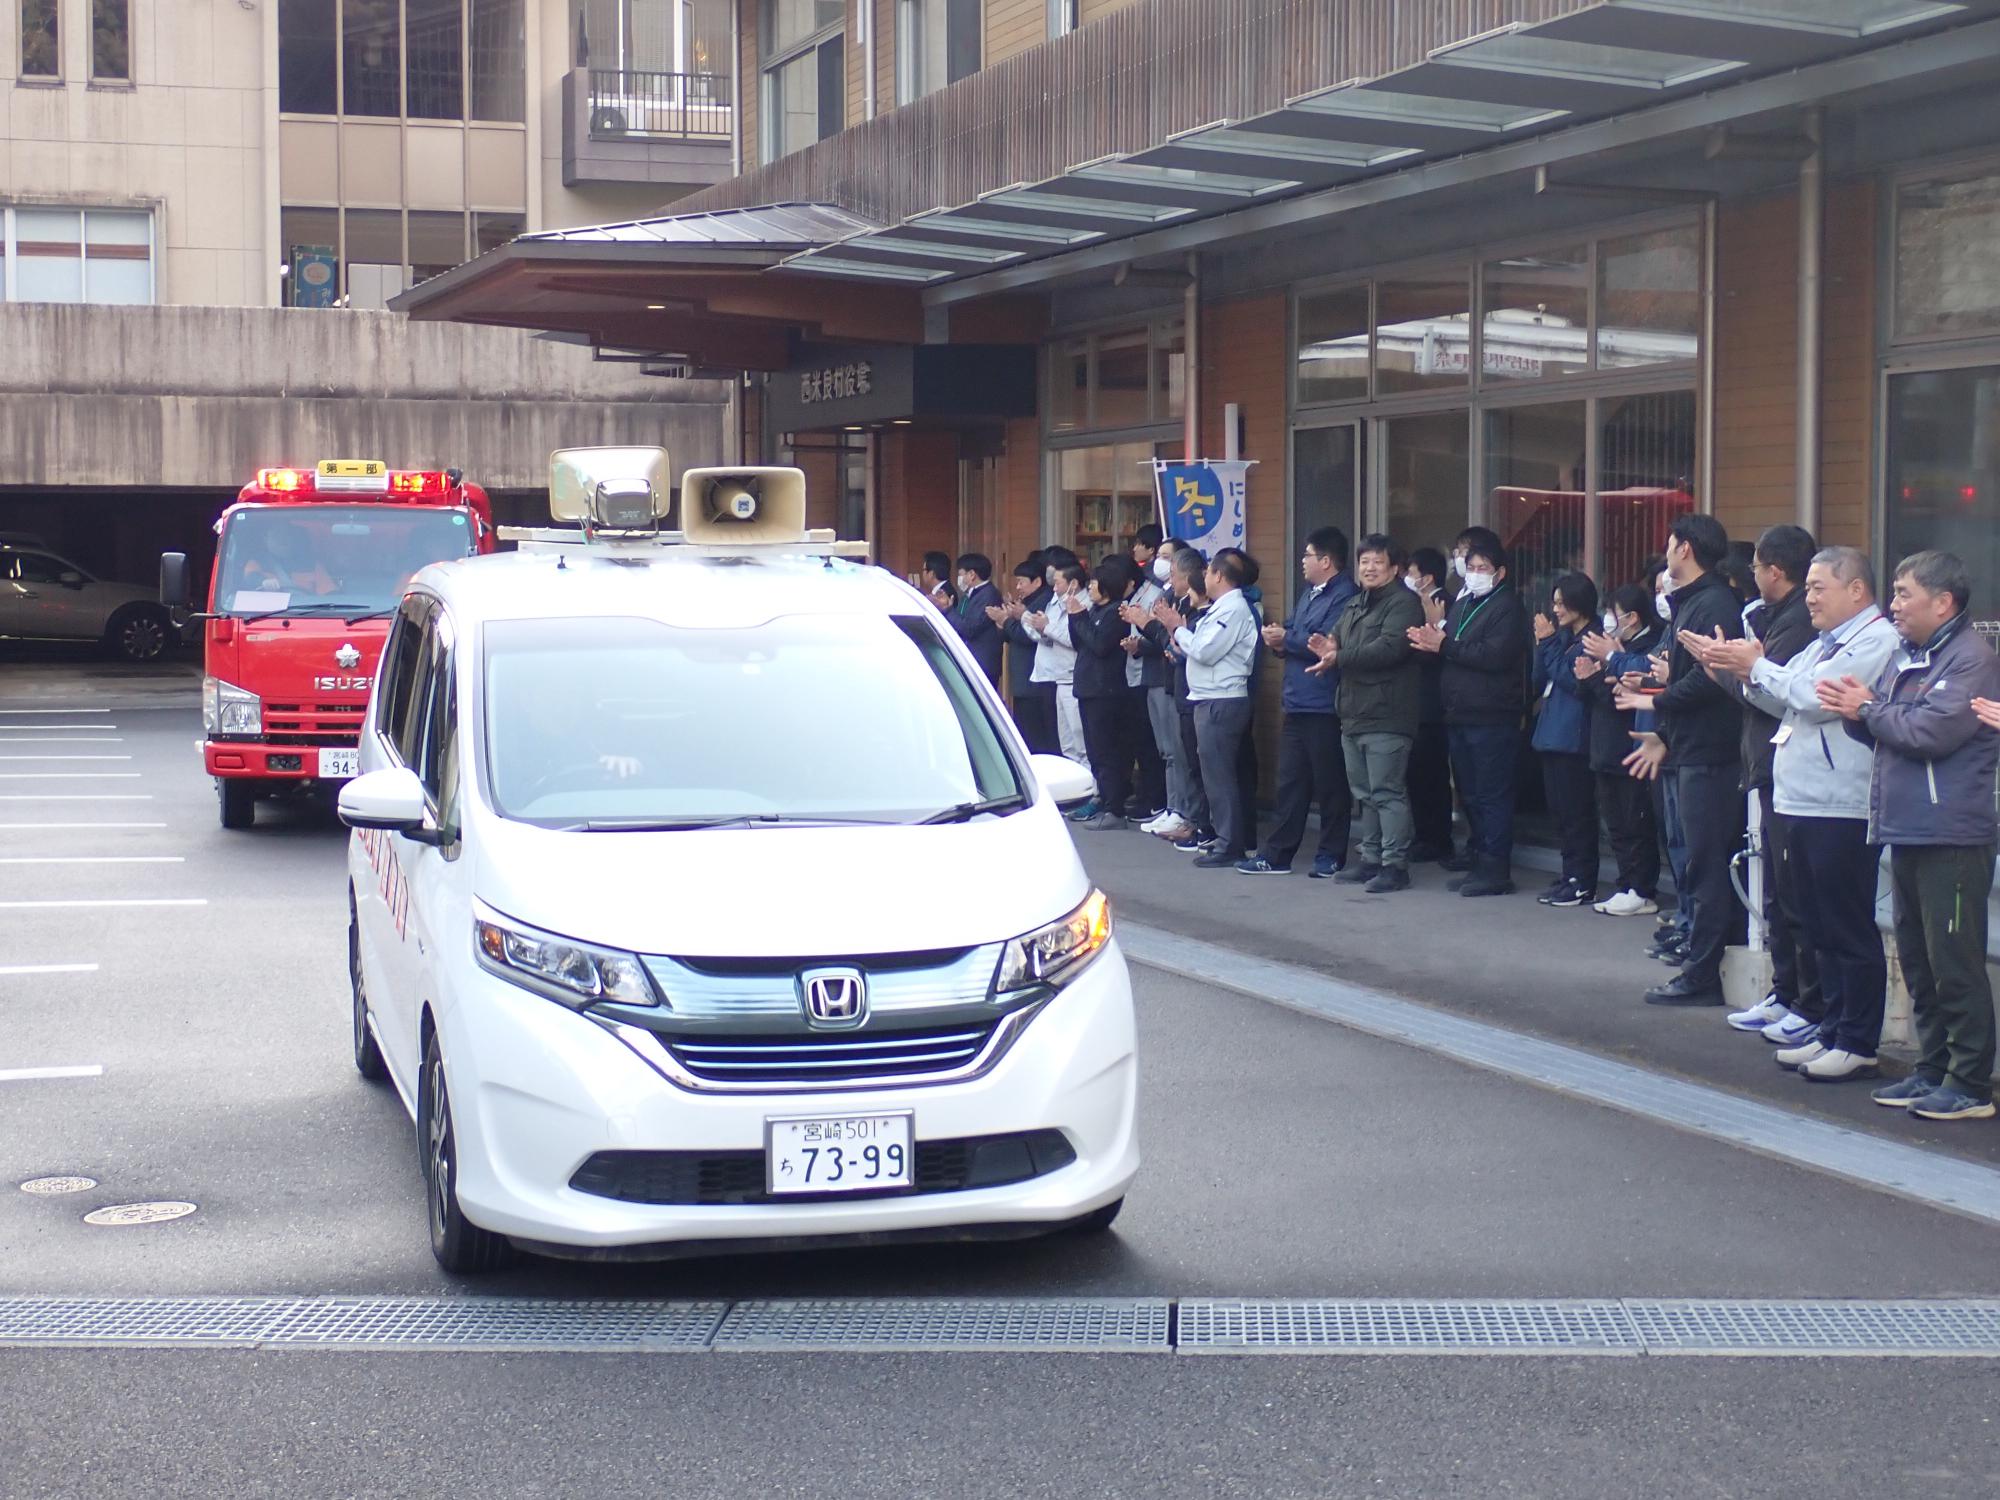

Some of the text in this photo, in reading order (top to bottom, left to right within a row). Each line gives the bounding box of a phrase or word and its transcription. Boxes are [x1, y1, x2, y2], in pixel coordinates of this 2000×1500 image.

[800, 361, 872, 404] 西米良村役場
[326, 463, 378, 475] 第一部
[1174, 476, 1216, 527] 冬
[1228, 481, 1244, 550] にしめ
[801, 1143, 904, 1183] 73-99
